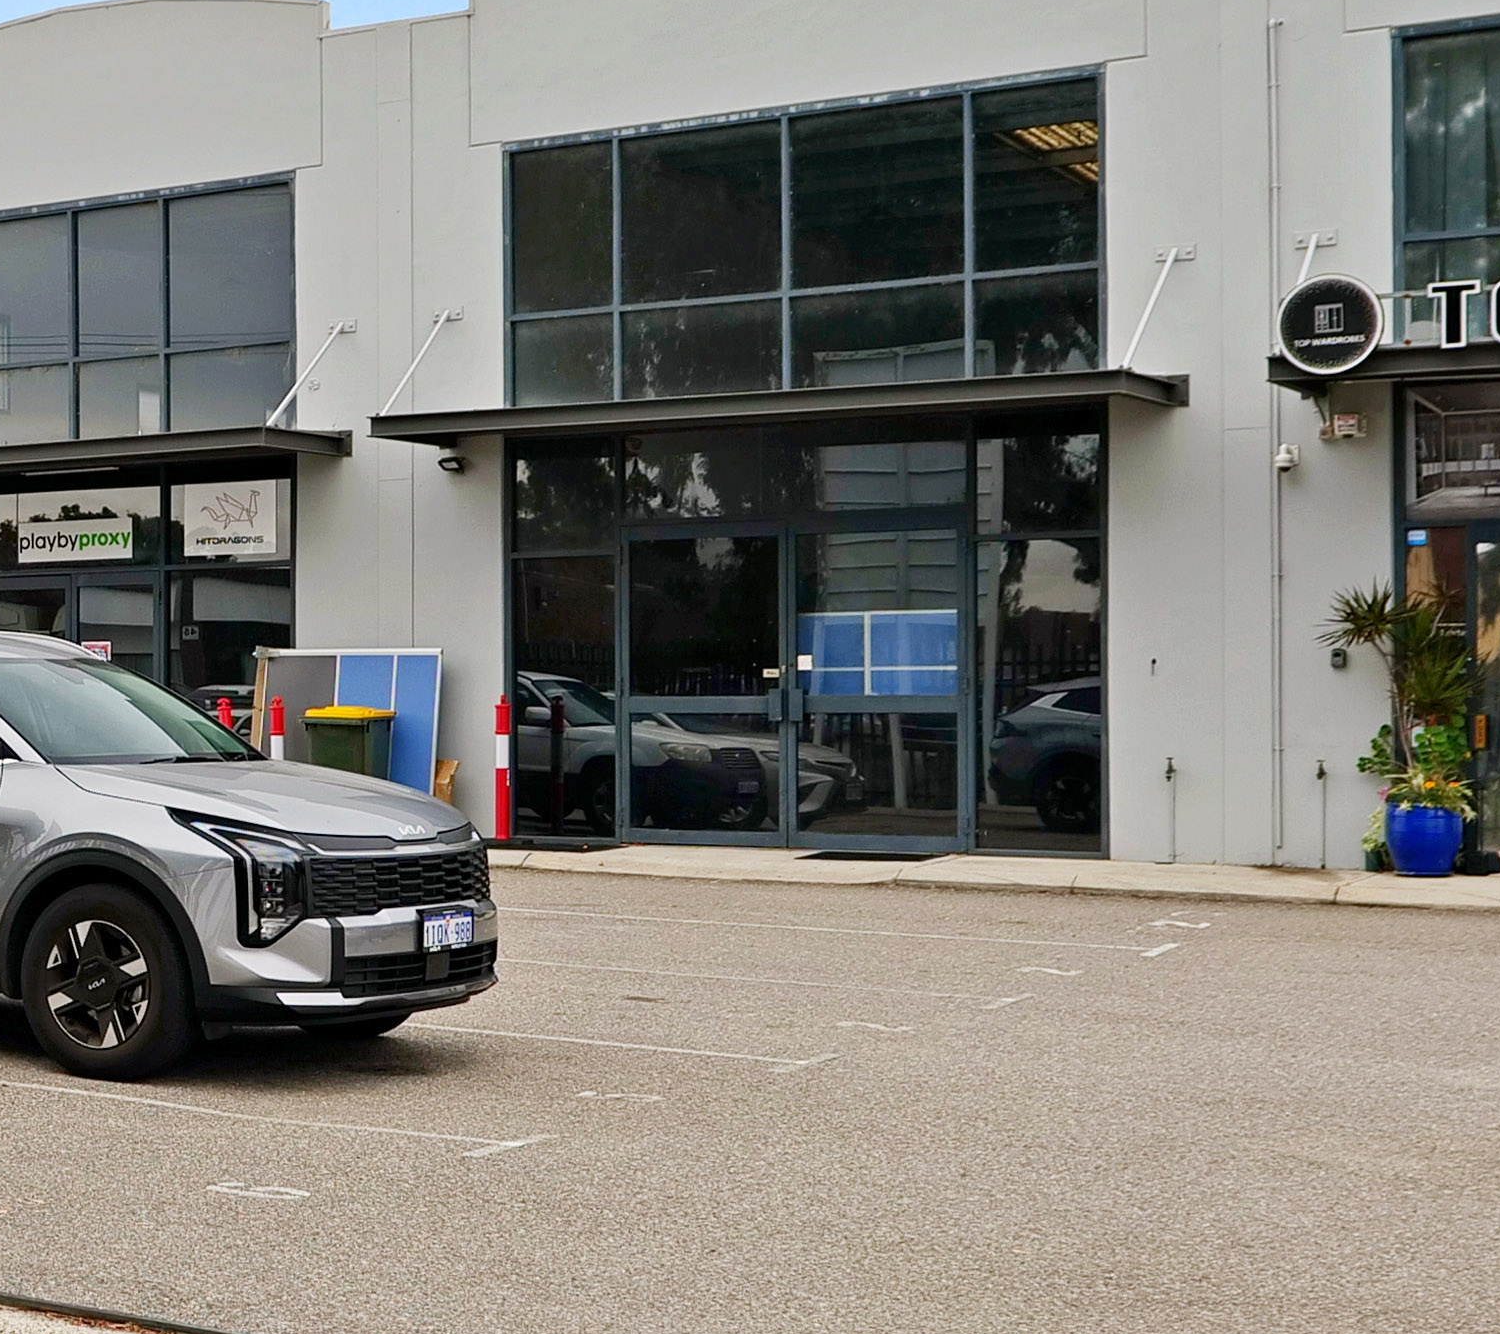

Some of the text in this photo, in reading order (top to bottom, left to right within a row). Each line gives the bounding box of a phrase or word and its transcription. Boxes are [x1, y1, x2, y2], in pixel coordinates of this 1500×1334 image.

[1294, 334, 1366, 348] TOP WARDROBES
[19, 530, 131, 553] playbyproxy
[196, 535, 264, 546] HITDRAGONS
[398, 825, 425, 835] KIA
